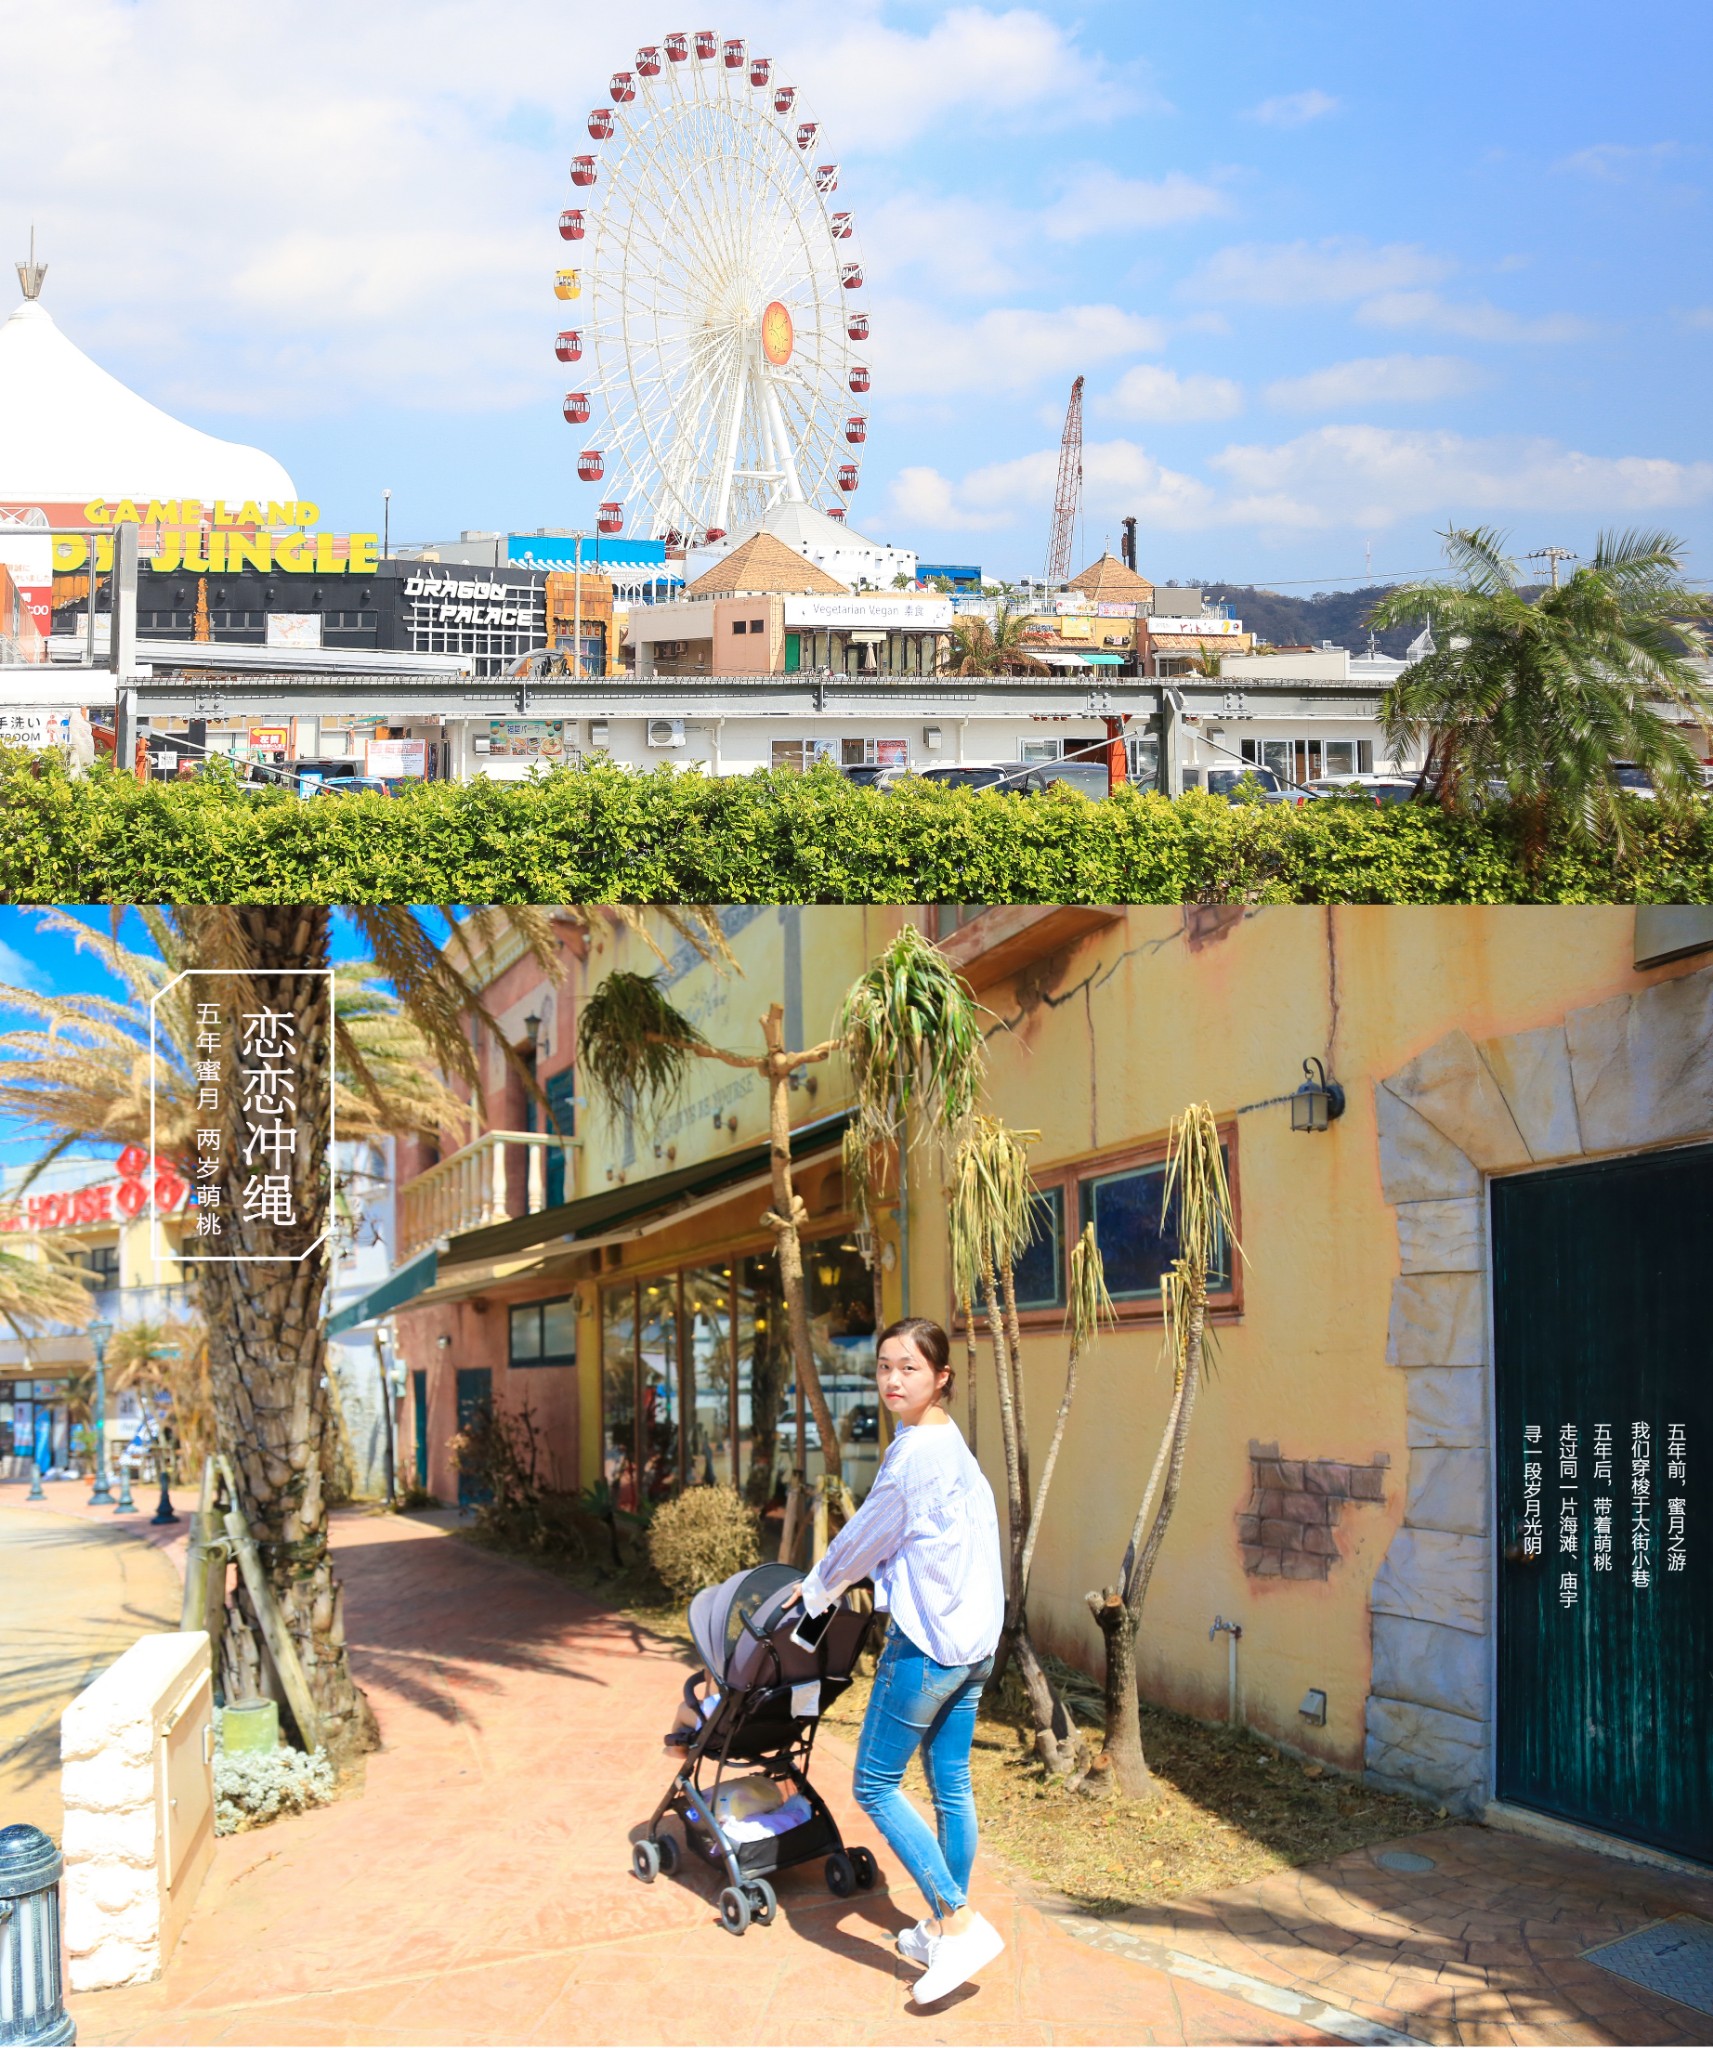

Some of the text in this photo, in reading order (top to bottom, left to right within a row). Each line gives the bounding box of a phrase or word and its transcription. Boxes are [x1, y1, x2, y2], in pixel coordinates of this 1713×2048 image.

[83, 498, 321, 526] GAME LAND
[149, 531, 380, 574] JUNGLE
[404, 577, 507, 601] DRAGON
[438, 604, 532, 627] PALACE
[813, 604, 925, 617] Vegetarian Vegan 素食
[1179, 622, 1215, 634] rib's
[27, 1185, 112, 1232] HOUSE
